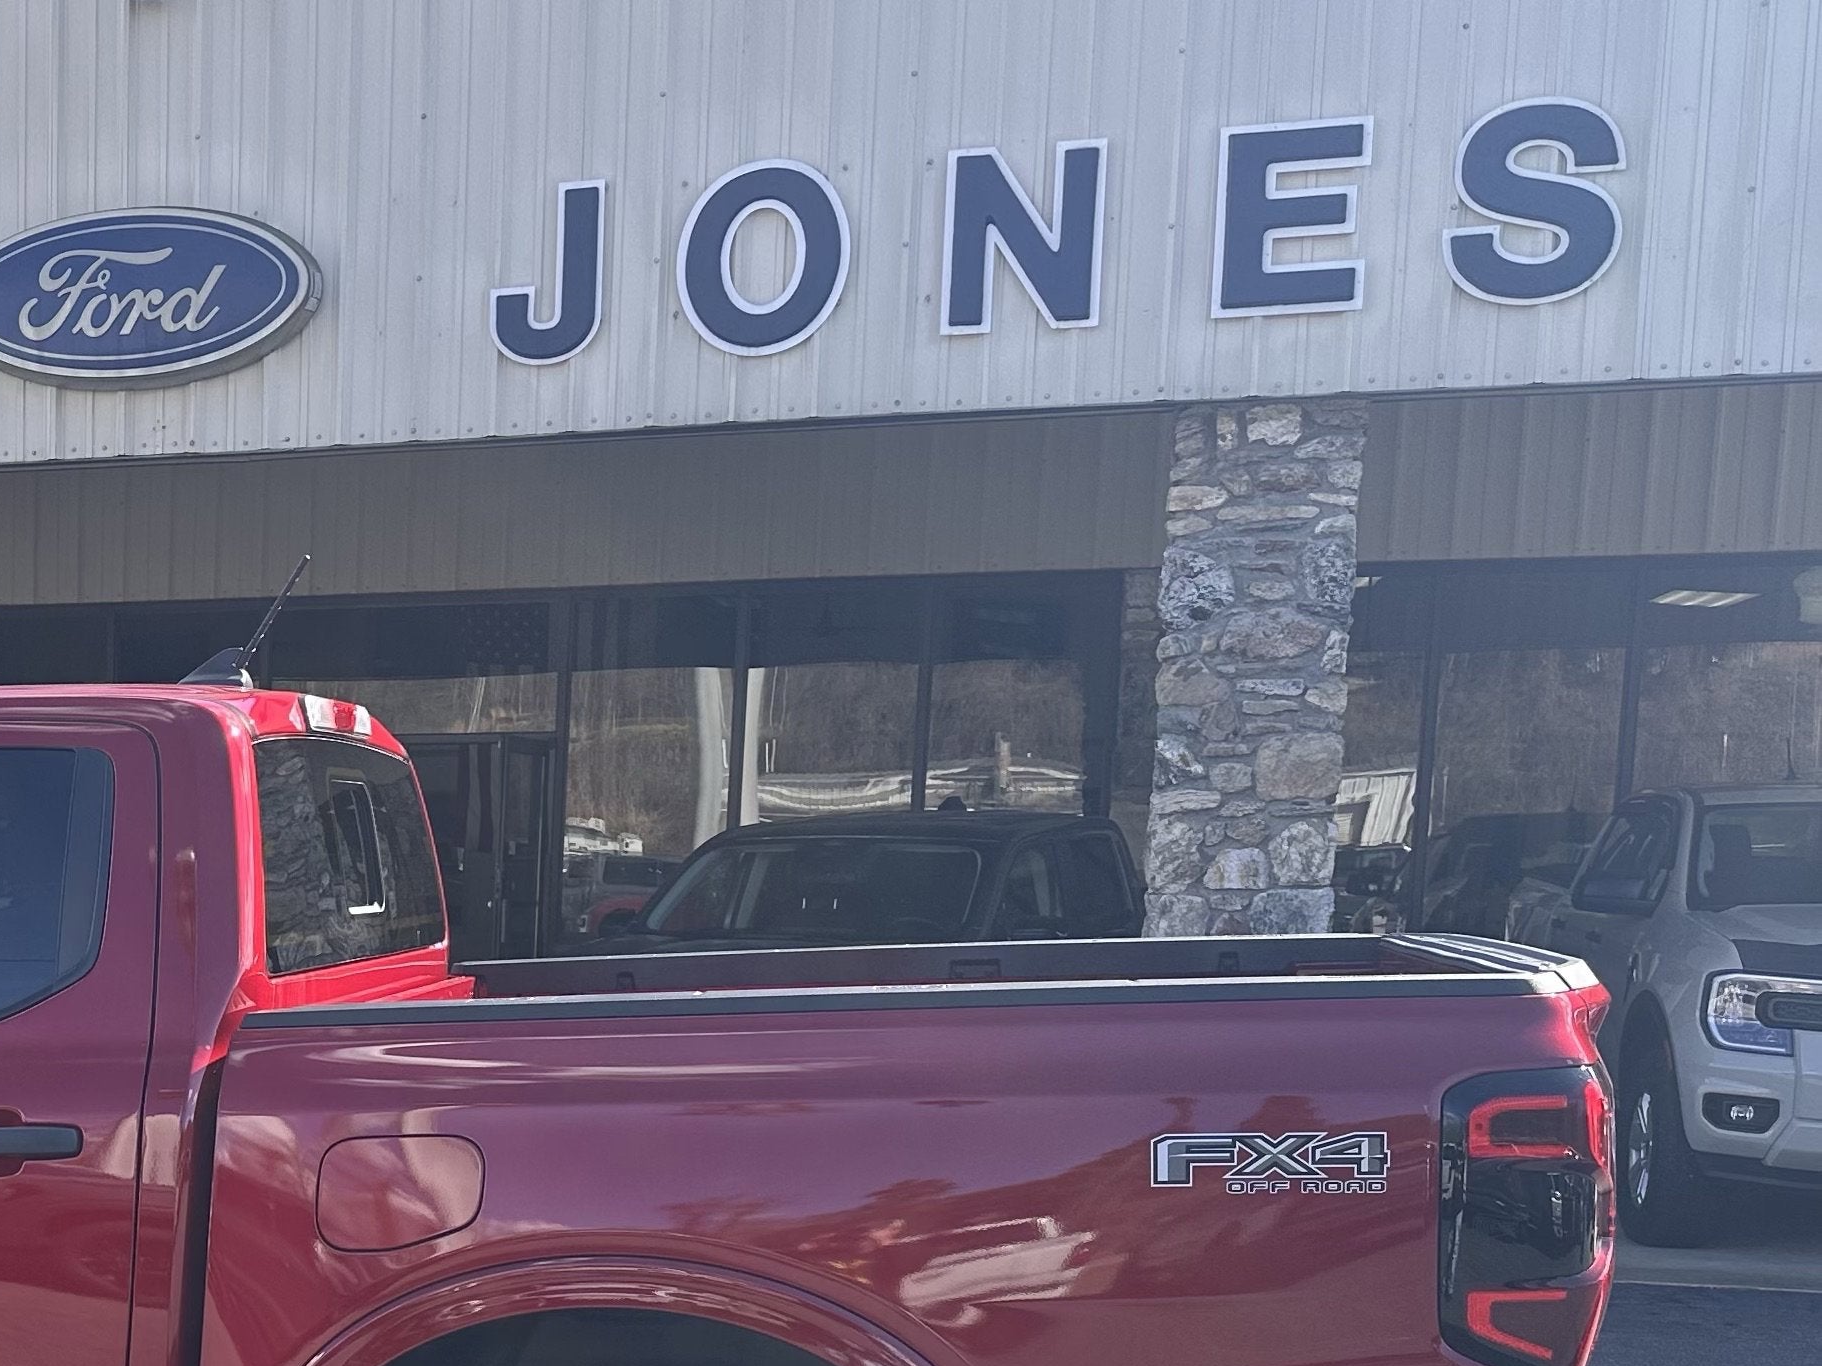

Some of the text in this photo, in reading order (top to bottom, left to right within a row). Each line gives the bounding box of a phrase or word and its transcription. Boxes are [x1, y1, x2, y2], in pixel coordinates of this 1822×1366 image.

[490, 96, 1627, 366] JONES
[18, 247, 227, 342] Ford
[1151, 1132, 1390, 1187] FX4
[1225, 1179, 1387, 1195] OFF ROAD
